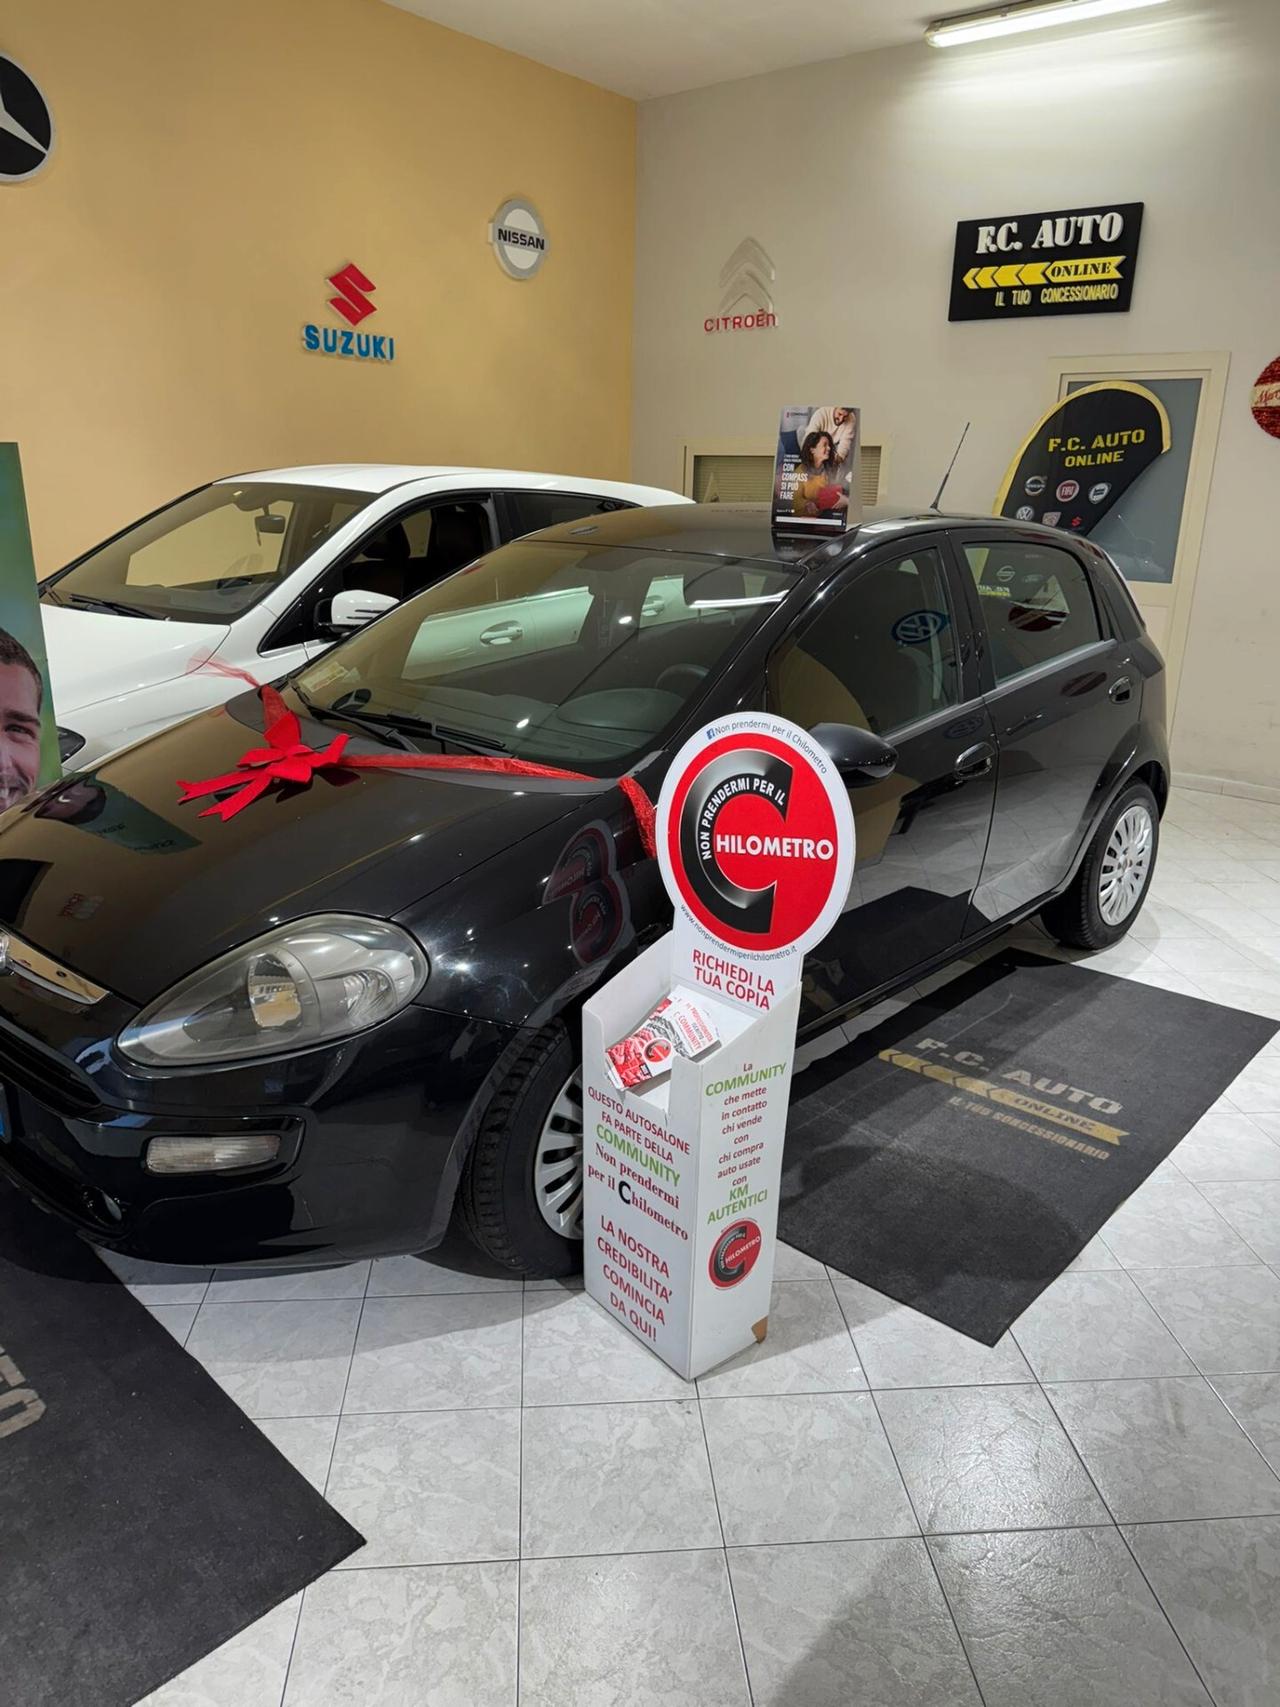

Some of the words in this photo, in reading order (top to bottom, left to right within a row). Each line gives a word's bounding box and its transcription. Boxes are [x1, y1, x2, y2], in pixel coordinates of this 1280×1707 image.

[497, 228, 545, 251] NISSAN
[976, 222, 1023, 254] F.C.
[1031, 212, 1124, 249] AUTO
[1051, 261, 1112, 278] ONLINE
[995, 291, 1006, 307] IL
[1012, 289, 1031, 305] TUO
[1040, 284, 1118, 304] CONCESSIONARIO
[303, 324, 395, 361] SUZUKI
[1048, 437, 1086, 452] F.C.
[1091, 428, 1146, 449] AUTO
[1064, 450, 1124, 468] ONLINE
[781, 472, 808, 482] COMPASS
[780, 491, 795, 500] FARE
[714, 725, 730, 735] Non
[731, 720, 771, 730] prendermi
[771, 723, 786, 735] per
[785, 728, 792, 738] il
[792, 734, 828, 775] Chilometro
[701, 777, 750, 828] PRENDERMI
[753, 778, 775, 796] PER
[774, 789, 787, 806] IL
[700, 831, 712, 860] NON
[693, 949, 753, 986] RICHIEDI
[757, 975, 775, 996] LA
[694, 966, 722, 990] TUA
[726, 981, 770, 1010] COPIA
[705, 1062, 787, 1097] COMMUNITY
[743, 1063, 753, 1072] La
[914, 1037, 990, 1072] F.C.
[1000, 1068, 1124, 1115] AUTO
[721, 1111, 730, 1121] in
[732, 1100, 767, 1118] contatto
[724, 1096, 739, 1106] che
[741, 1087, 767, 1101] mette
[588, 1086, 623, 1114] QUESTO
[625, 1108, 690, 1155] AUTOSALONE
[722, 1123, 735, 1135] chi
[736, 1114, 762, 1130] vende
[965, 1101, 993, 1116] TUO
[992, 1112, 1110, 1160] CONCESSIONARIO
[1015, 1098, 1097, 1131] ONLINE
[601, 1111, 612, 1126] FA
[614, 1119, 642, 1145] PARTE
[644, 1137, 674, 1164] DELLA
[718, 1152, 731, 1164] chi
[733, 1142, 764, 1159] compra
[733, 1134, 749, 1145] con
[596, 1124, 680, 1187] COMMUNITY
[717, 1165, 737, 1179] auto
[738, 1156, 761, 1170] usate
[596, 1142, 616, 1167] Non
[619, 1162, 679, 1209] prendermi
[729, 1183, 749, 1201] KM
[732, 1175, 747, 1186] con
[588, 1164, 605, 1182] per
[608, 1175, 615, 1191] il
[618, 1180, 688, 1241] Chilometro
[707, 1189, 768, 1225] AUTENTICI
[601, 1214, 615, 1237] LA
[618, 1228, 669, 1279] NOSTRA
[597, 1236, 673, 1304] CREDIBILITA'
[603, 1264, 665, 1326] COMINCIA
[610, 1291, 626, 1317] DA
[629, 1309, 657, 1342] QUI!
